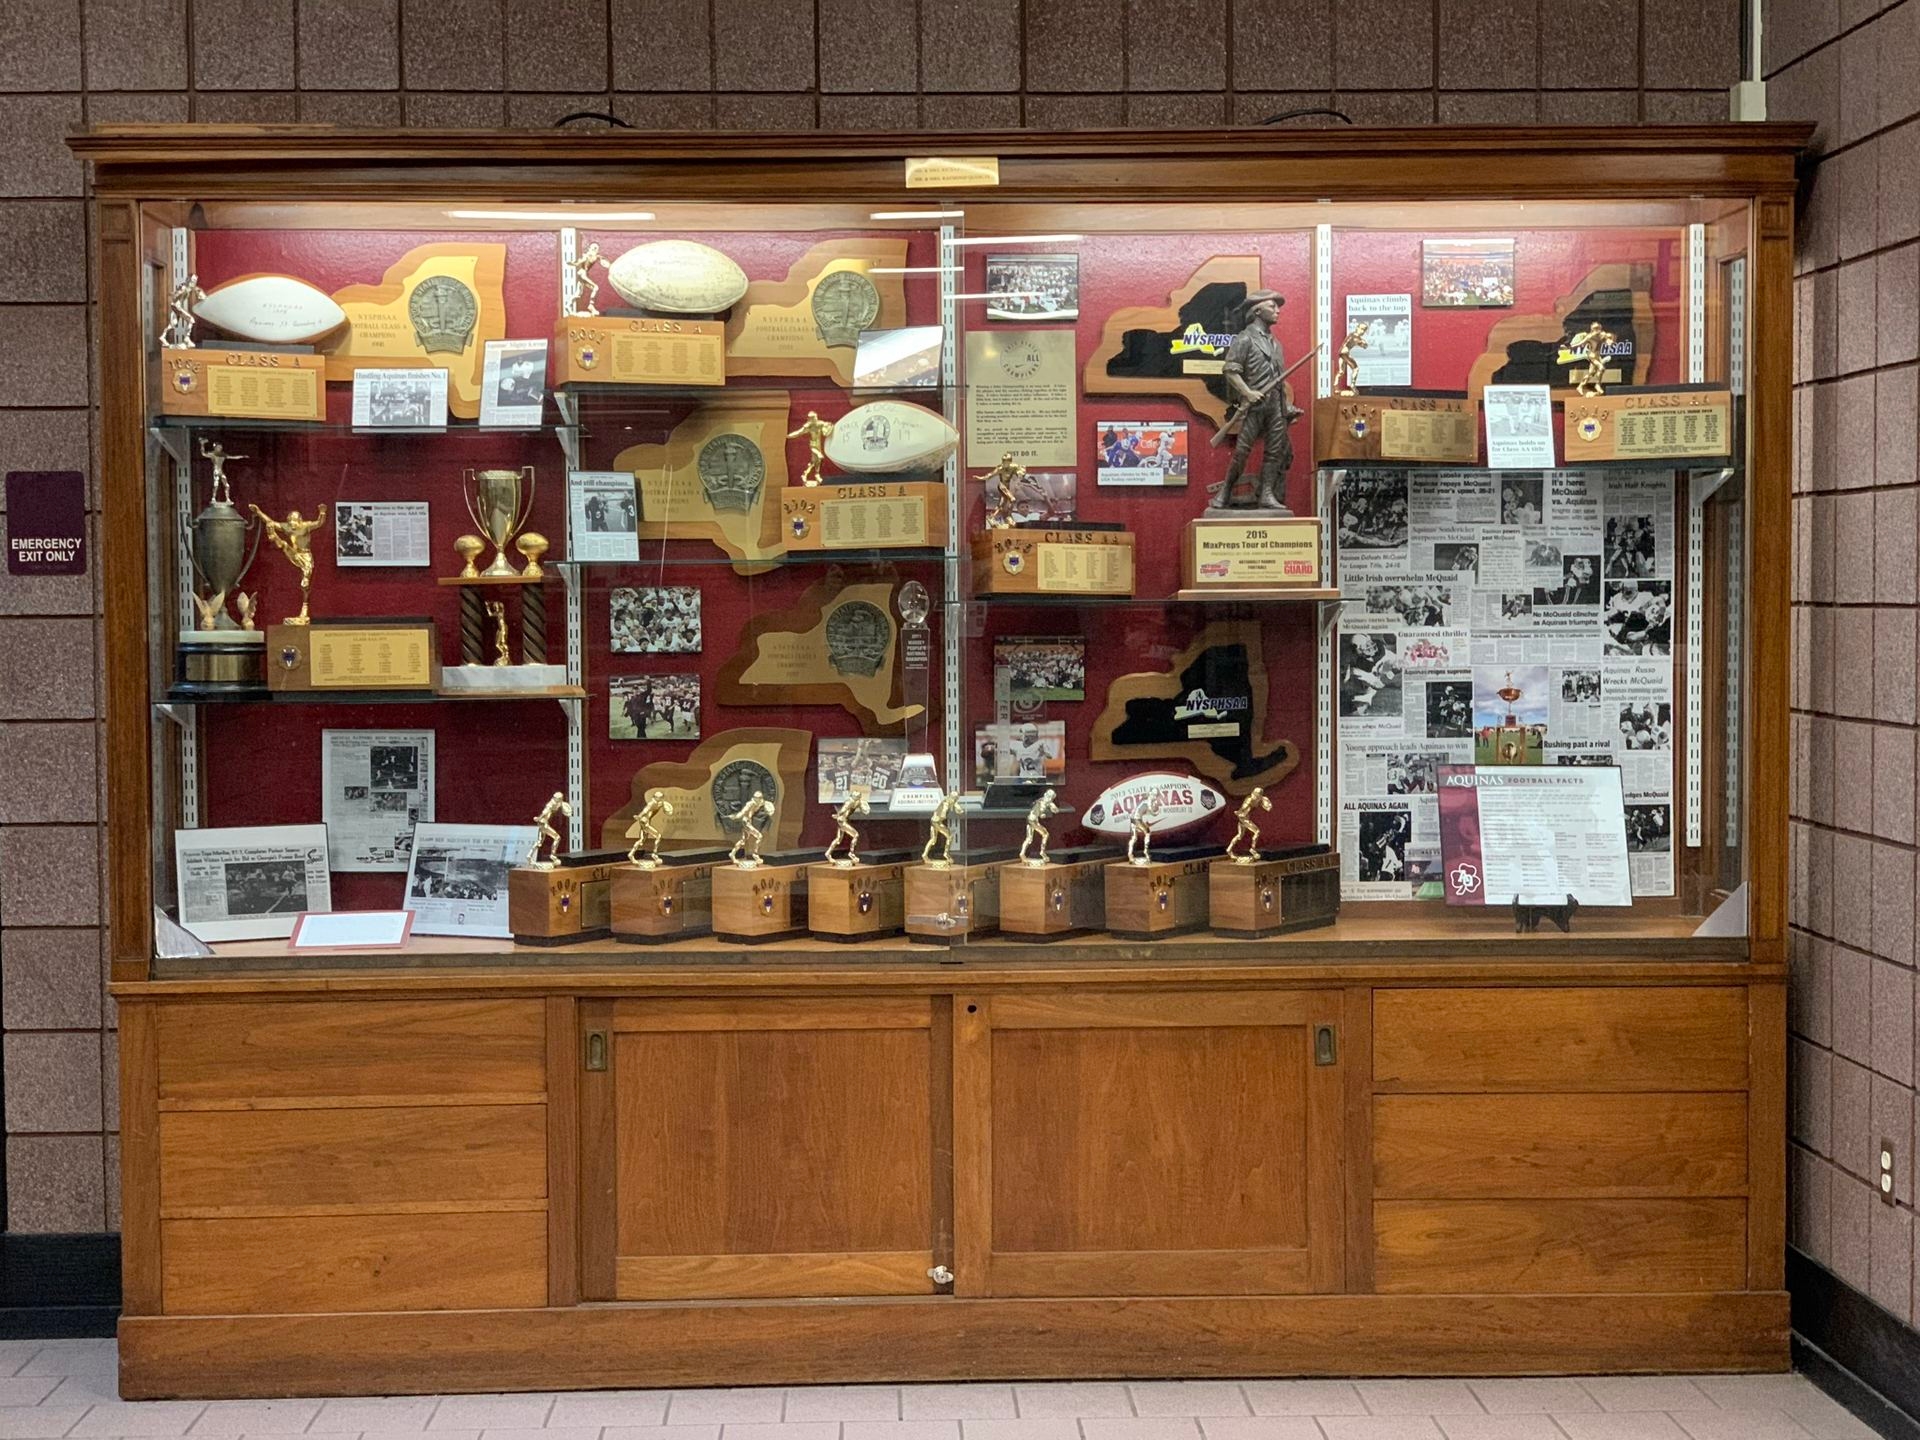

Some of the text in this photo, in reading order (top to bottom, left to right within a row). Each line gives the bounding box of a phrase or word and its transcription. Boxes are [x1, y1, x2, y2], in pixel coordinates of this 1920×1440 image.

[629, 320, 702, 334] CLASS A
[226, 353, 300, 368] CLASS A
[1027, 354, 1039, 362] ALL
[356, 372, 381, 380] Hustling
[382, 372, 407, 380] Aquinas
[1389, 398, 1437, 410] CLASS
[1624, 396, 1681, 409] CLASS
[837, 485, 906, 499] CLASS A
[1044, 532, 1093, 544] CLASS
[1246, 530, 1268, 539] 2015
[12, 538, 82, 549] EMERGENCY
[1203, 541, 1240, 549] MaxPreps
[1270, 541, 1313, 549] Champions
[19, 551, 75, 561] EXIT ONLY
[1284, 565, 1313, 574] GUARD
[1344, 574, 1363, 582] Little
[1426, 574, 1458, 582] McQuaid
[1186, 696, 1248, 711] NYSPHSAA
[1345, 743, 1366, 752] Young
[1368, 743, 1399, 752] approach
[1420, 743, 1445, 751] Aquinas
[1544, 740, 1571, 749] Rushing
[1573, 740, 1588, 749] past
[1020, 757, 1035, 771] 12
[835, 776, 847, 790] 21
[872, 772, 888, 789] 20
[1446, 775, 1504, 787] AQUINAS
[1128, 786, 1146, 795] STATE
[1112, 790, 1194, 816] AQUNAS
[1344, 802, 1355, 810] ALL
[1358, 802, 1387, 810] AQUINAS
